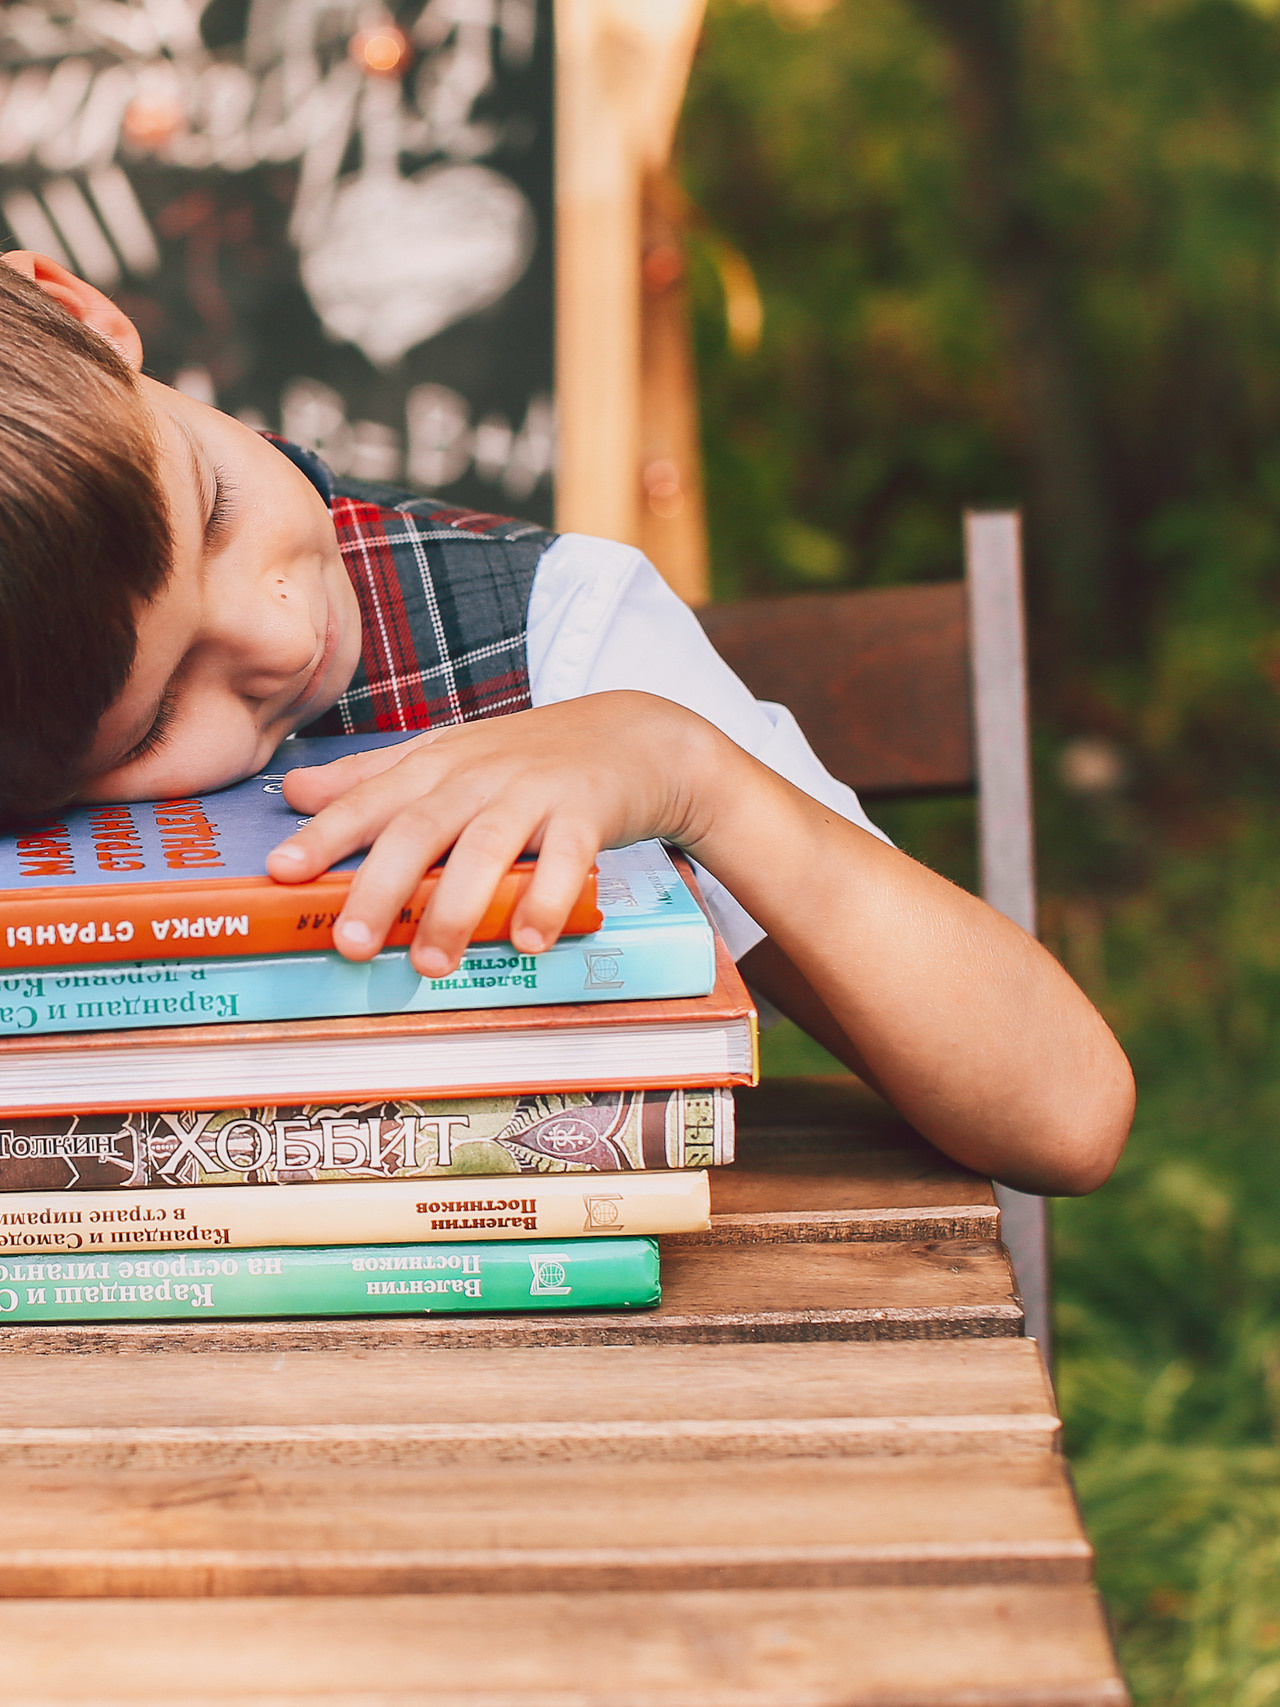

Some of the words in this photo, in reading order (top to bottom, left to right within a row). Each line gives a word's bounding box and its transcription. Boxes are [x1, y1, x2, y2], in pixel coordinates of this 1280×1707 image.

[16, 816, 76, 876] МАРКА
[86, 806, 145, 871] СТРАНЫ
[6, 920, 135, 948] СТРАНЫ
[151, 914, 249, 941] МАРКА
[192, 970, 206, 980] в
[430, 973, 537, 990] Валентин
[48, 1003, 67, 1020] и
[77, 992, 240, 1019] Карандаш
[159, 1112, 471, 1175] ХОББИТ
[90, 1205, 167, 1223] стране
[174, 1208, 186, 1220] в
[415, 1198, 537, 1214] Постников
[431, 1215, 538, 1231] Валентин
[89, 1232, 104, 1244] и
[110, 1225, 231, 1245] Карандаш
[118, 1259, 239, 1281] острове
[247, 1257, 283, 1275] на
[352, 1255, 482, 1275] Постников
[26, 1287, 47, 1306] и
[54, 1280, 215, 1308] Карандаш
[366, 1278, 482, 1298] Валентин
